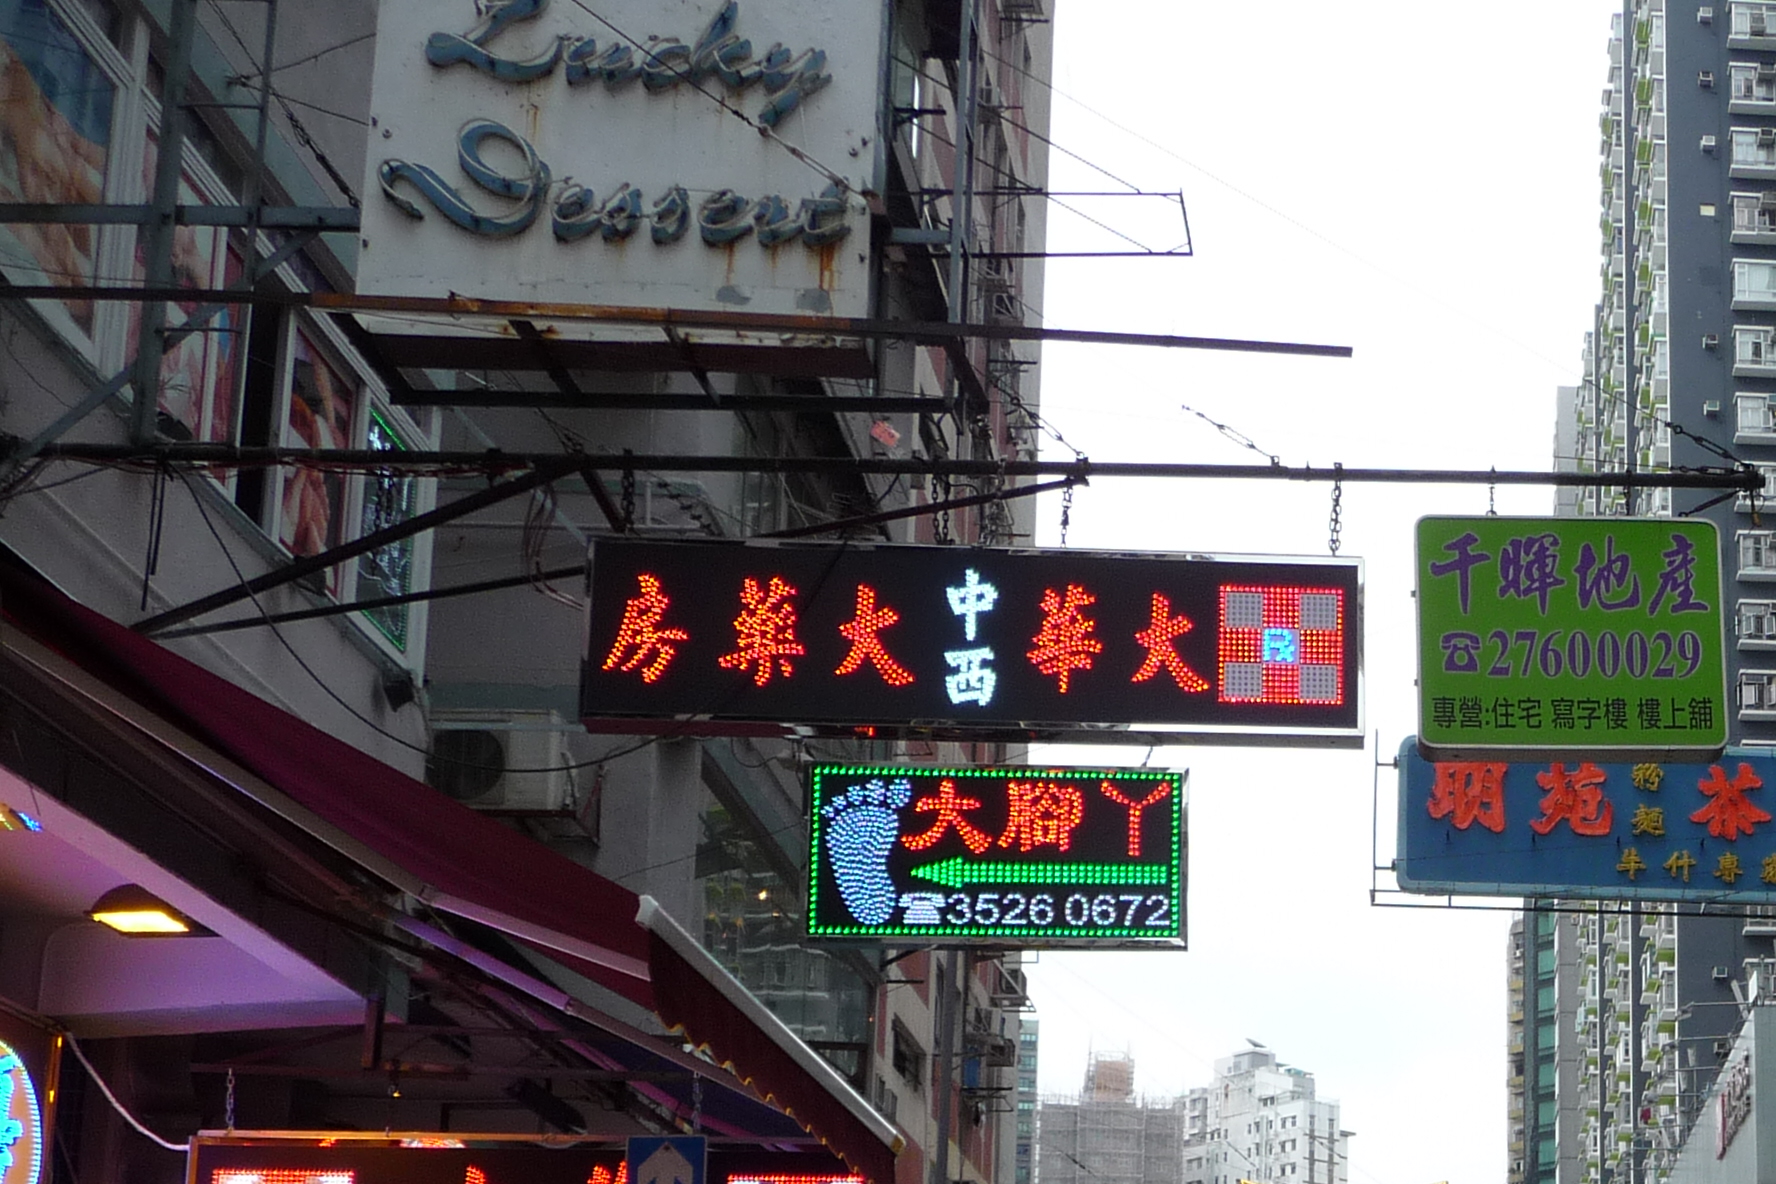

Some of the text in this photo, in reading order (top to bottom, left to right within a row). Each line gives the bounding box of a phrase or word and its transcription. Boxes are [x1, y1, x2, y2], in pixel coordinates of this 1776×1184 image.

[425, 0, 833, 128] Lucky
[377, 117, 853, 247] Dessert
[1430, 532, 1711, 618] 千暉地產
[1488, 629, 1701, 681] 27600029
[947, 891, 1172, 926] 3526 0672
